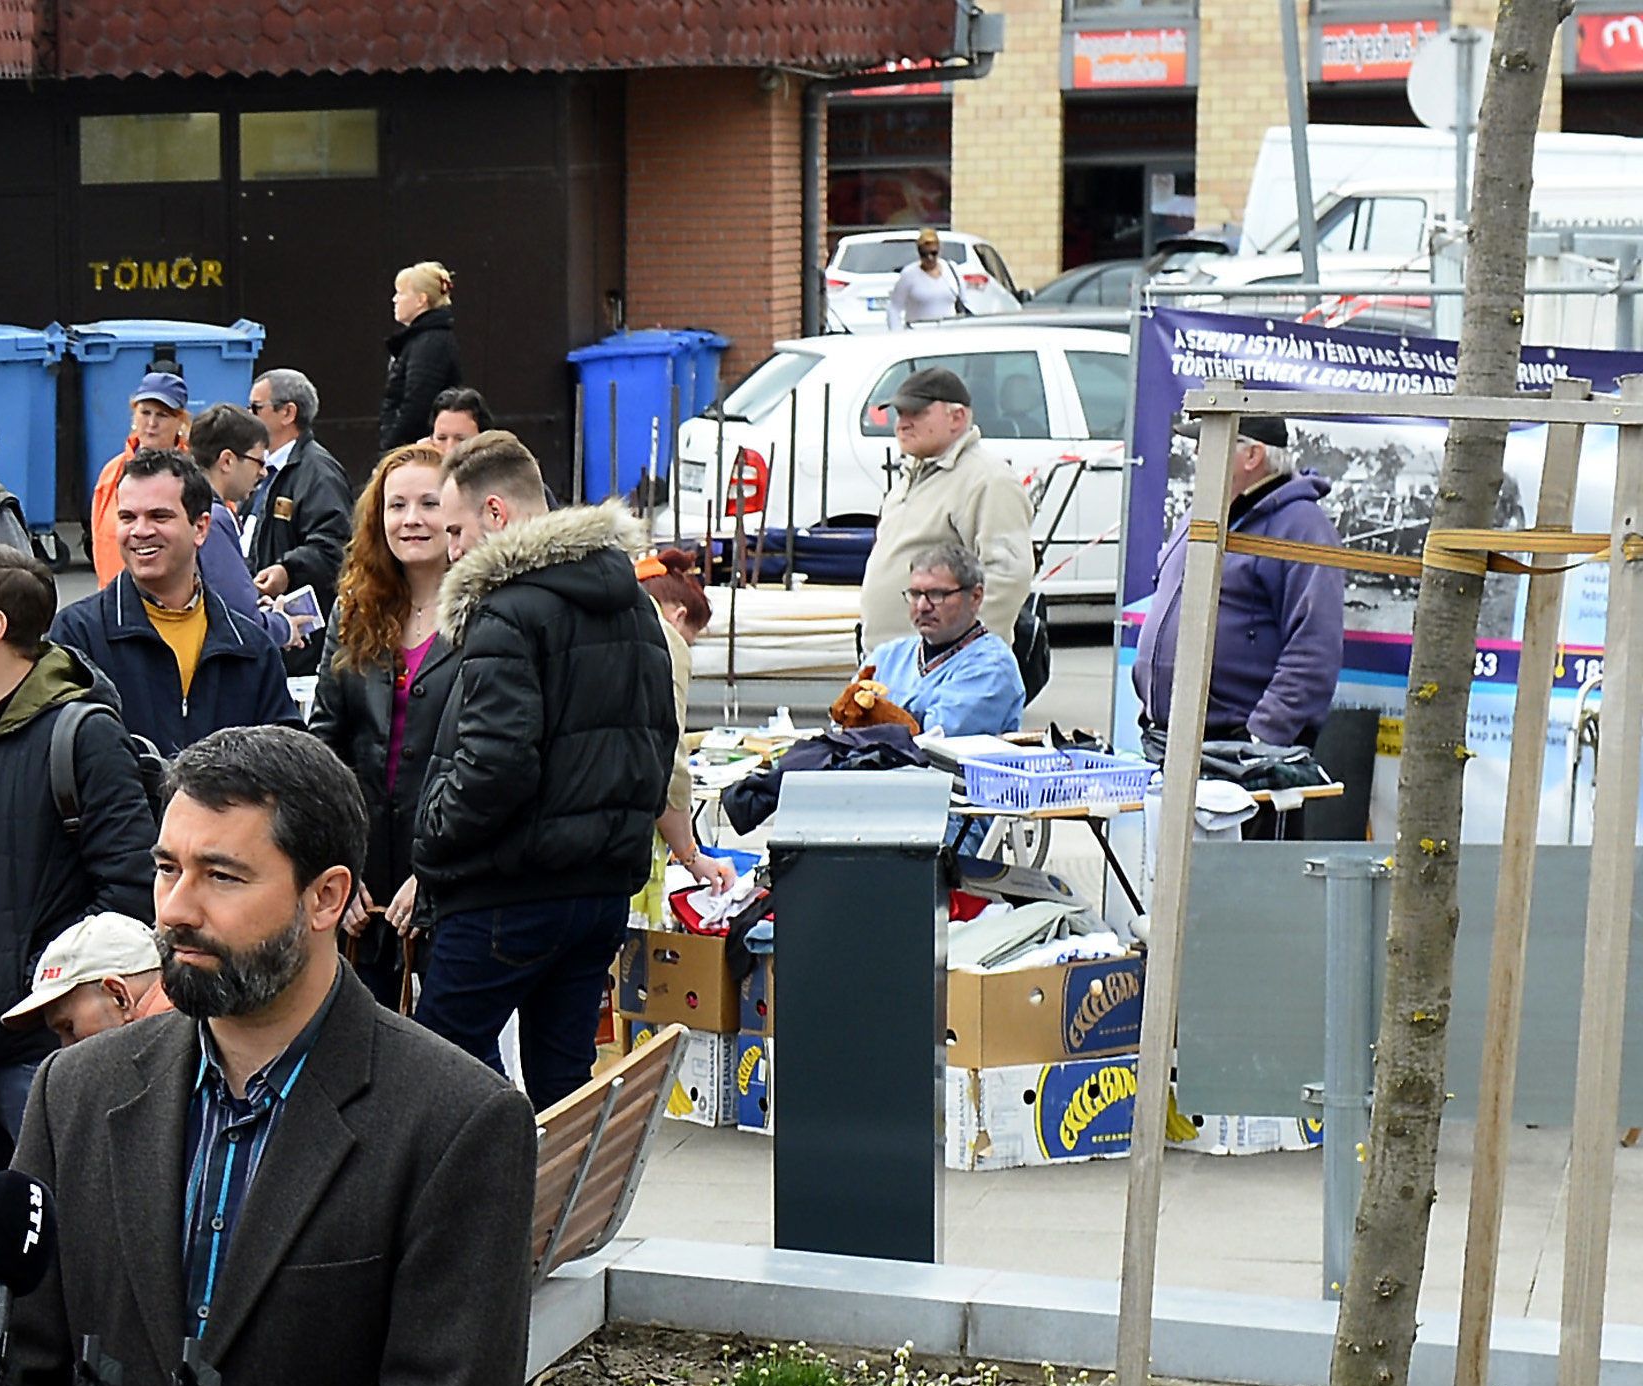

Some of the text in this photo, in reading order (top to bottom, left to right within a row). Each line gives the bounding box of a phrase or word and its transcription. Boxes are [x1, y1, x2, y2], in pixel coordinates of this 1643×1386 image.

[1174, 328, 1187, 349] A
[1185, 328, 1246, 353] SZENT
[1244, 333, 1313, 360] ISTVÁN
[1314, 337, 1357, 364] TÉRI
[1356, 344, 1400, 368] PIAC
[1401, 345, 1424, 370] ÉS
[22, 1183, 43, 1254] RTL
